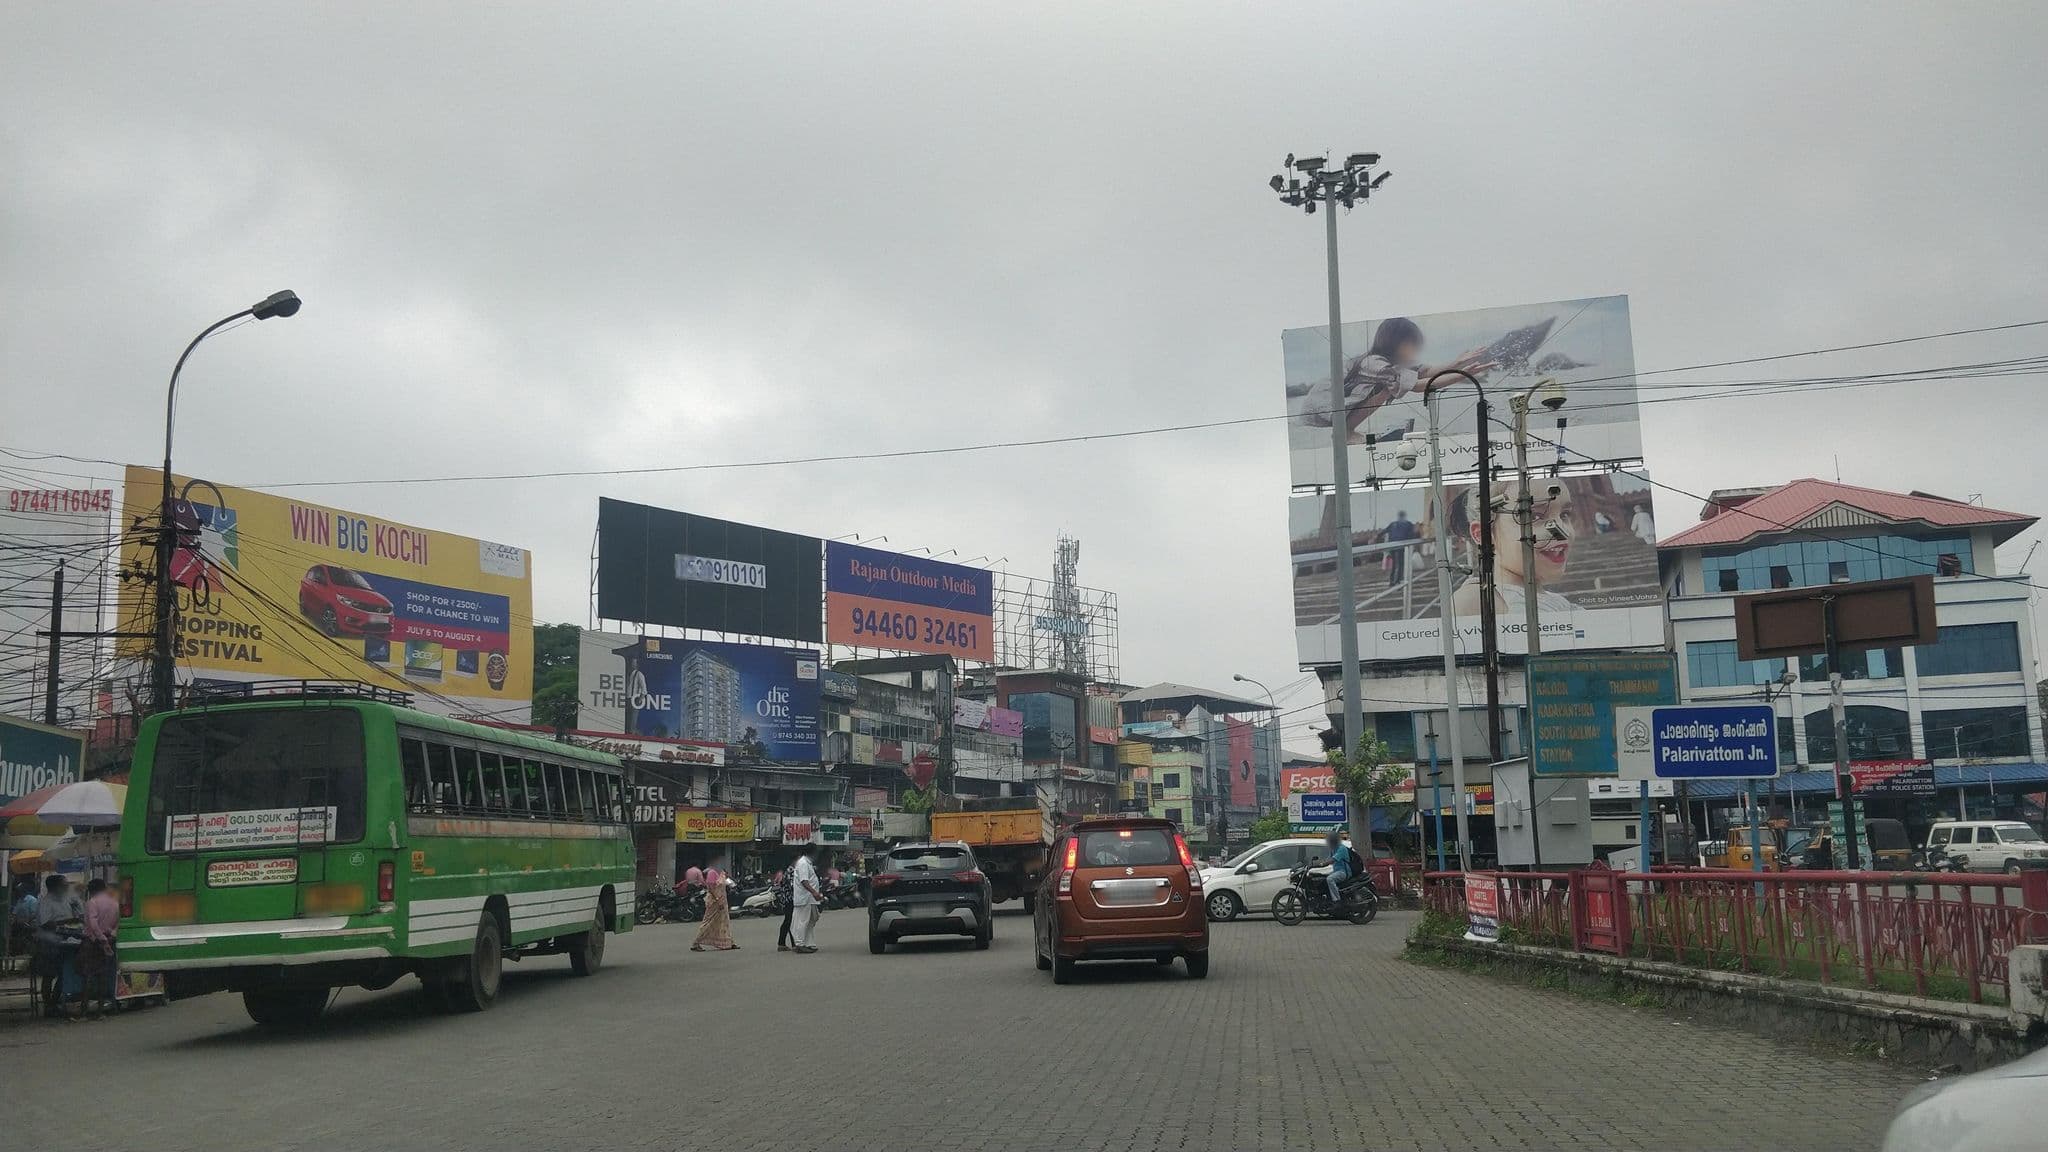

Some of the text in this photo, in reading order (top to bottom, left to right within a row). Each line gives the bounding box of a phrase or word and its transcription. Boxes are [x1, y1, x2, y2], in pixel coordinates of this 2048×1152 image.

[1371, 447, 1427, 462] Caped
[1524, 439, 1553, 449] eries
[10, 489, 111, 512] 9744116045
[290, 504, 428, 567] WIN BIG KOCHI
[851, 559, 977, 596] Rajan Outdoor Media
[177, 592, 221, 616] ULU
[406, 591, 430, 602] SHOP
[432, 595, 449, 606] FOR
[1578, 593, 1658, 605] Shot by Vineet Vohra
[406, 603, 500, 625] FOR A CHANCE TO WIN
[175, 615, 263, 640] HOPPING
[406, 625, 424, 635] JULY
[433, 629, 444, 638] TO
[445, 631, 475, 642] AUGUST
[852, 607, 978, 650] 94460 32461
[1382, 627, 1440, 642] Captured
[175, 634, 263, 663] ESTIVAL
[412, 649, 434, 660] acer
[599, 673, 625, 691] BE
[590, 690, 672, 711] THE ONE
[767, 685, 790, 703] the
[1660, 719, 1719, 743] പാലാരിവട്ടം
[1662, 744, 1769, 763] Palarivattom Jn.
[229, 813, 282, 825] GOLD SOUK
[1792, 921, 1804, 938] SL
[1882, 928, 1896, 945] SL
[1992, 938, 2009, 957] SL
